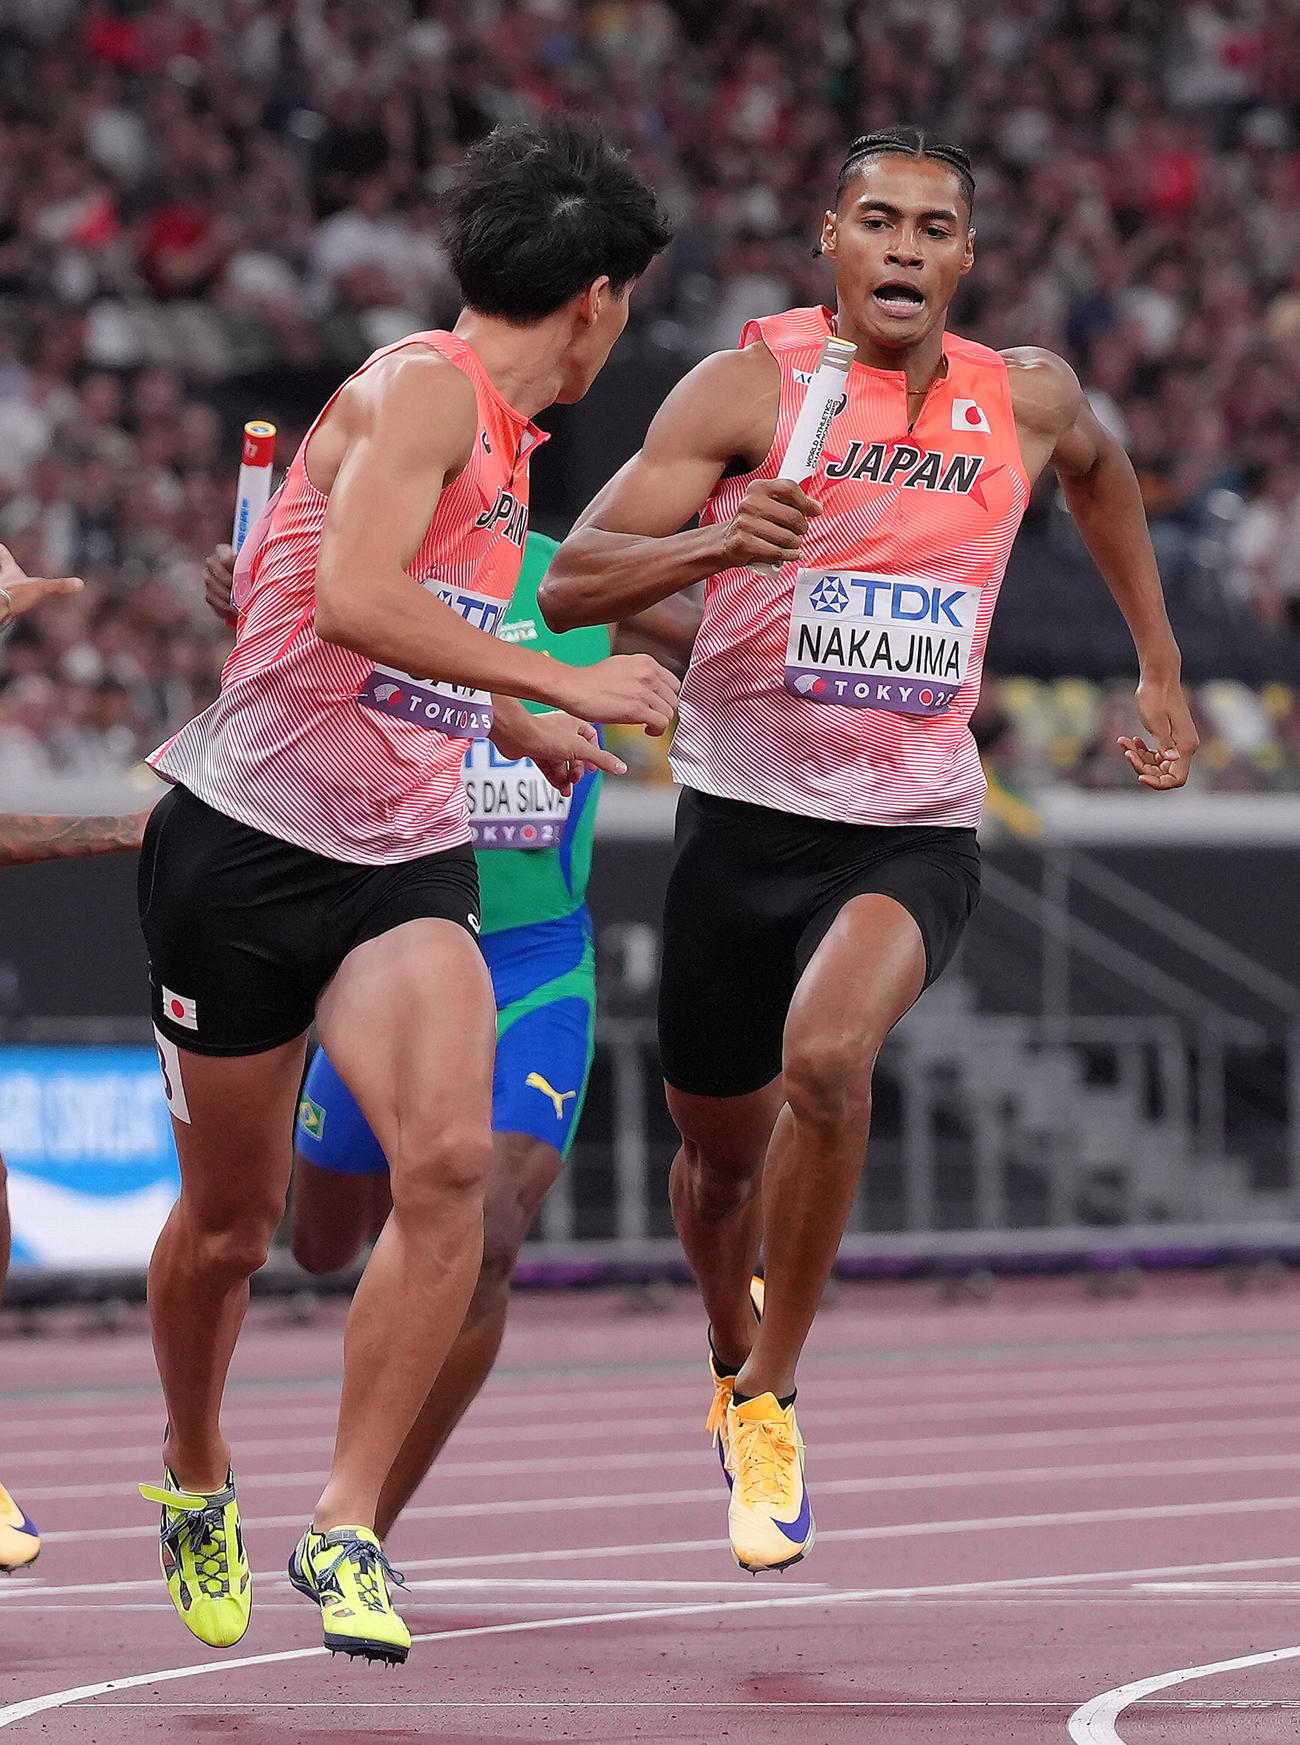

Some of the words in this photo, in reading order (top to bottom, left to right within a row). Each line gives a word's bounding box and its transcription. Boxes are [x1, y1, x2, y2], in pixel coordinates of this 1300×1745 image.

[805, 440, 819, 468] WORLD
[816, 399, 833, 439] ATHLETICS
[826, 440, 984, 495] JAPAN
[476, 486, 528, 548] JPAN
[851, 578, 967, 628] TDK
[797, 624, 961, 680] NAKAJIMA
[483, 781, 511, 814] DA
